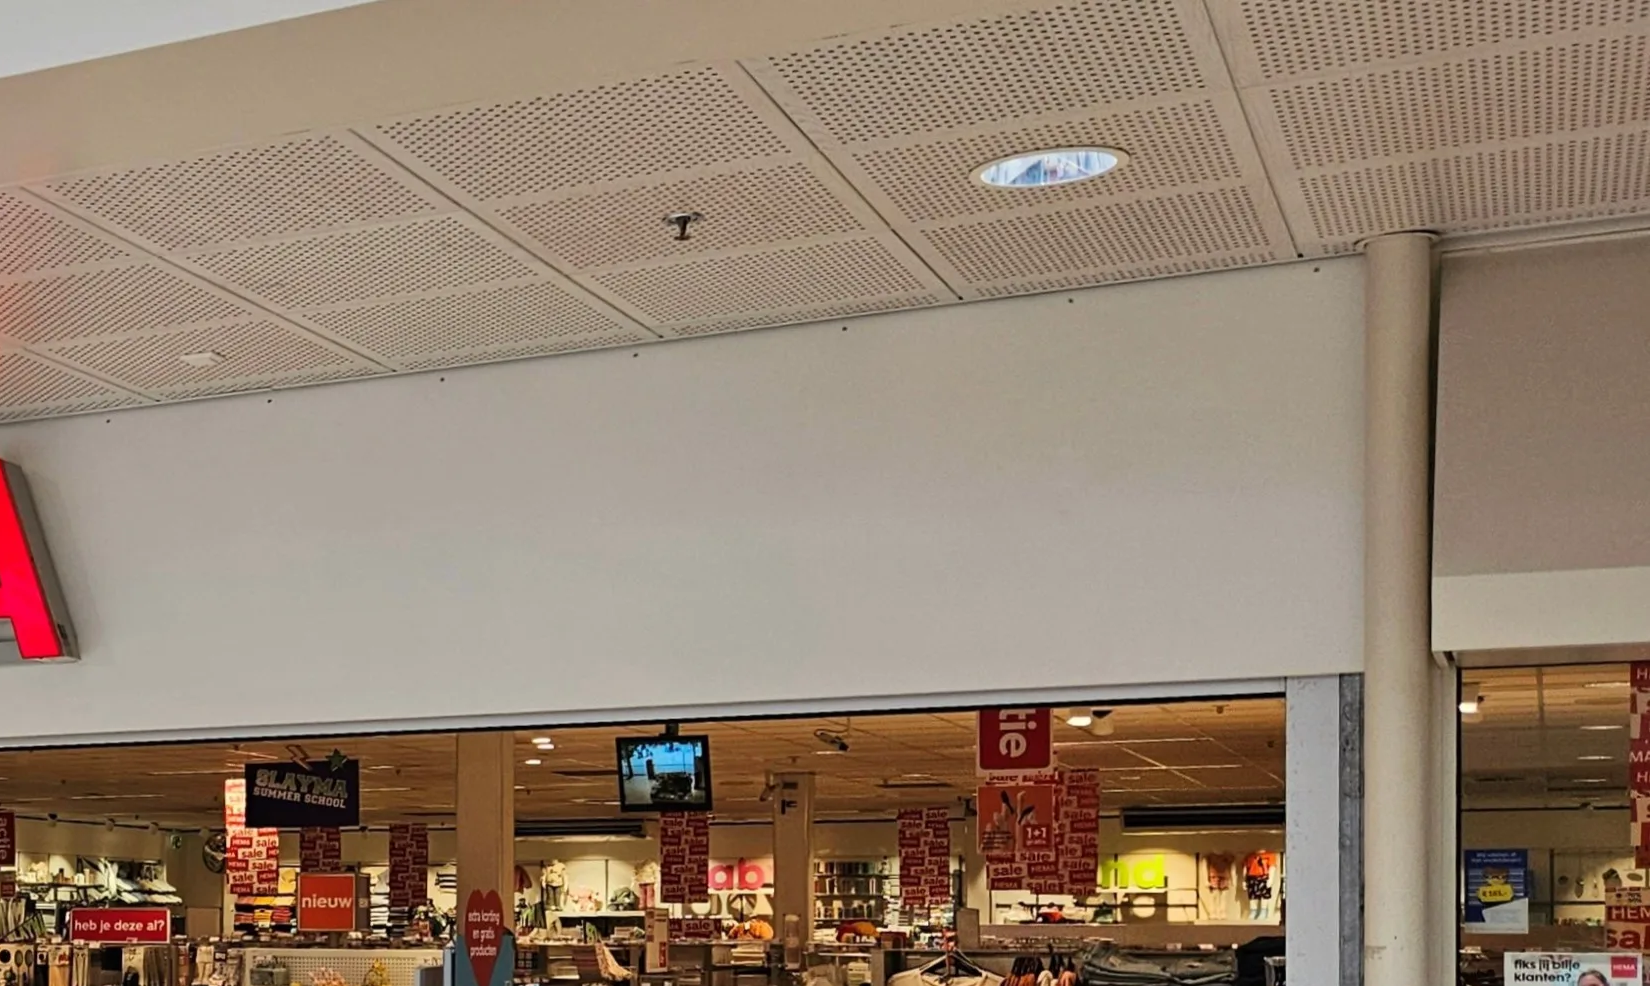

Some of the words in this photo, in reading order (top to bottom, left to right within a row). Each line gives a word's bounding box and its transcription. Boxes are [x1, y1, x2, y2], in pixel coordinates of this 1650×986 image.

[999, 709, 1037, 758] tie
[254, 768, 348, 799] SLAYMA
[252, 786, 301, 802] SUMMER
[304, 794, 346, 808] SCHOOL
[1025, 826, 1047, 840] 1+1
[255, 838, 278, 848] sale
[241, 848, 264, 859] sale
[251, 859, 274, 870] sale
[993, 863, 1023, 876] sale
[1100, 853, 1165, 889] nd
[231, 872, 255, 883] sale
[708, 857, 766, 891] ab
[255, 884, 278, 894] sale
[301, 893, 353, 909] nieuw
[1611, 905, 1650, 919] HEM
[74, 918, 97, 932] heb
[99, 919, 112, 934] je
[113, 918, 145, 932] deze
[146, 917, 166, 932] al?
[685, 919, 711, 931] sale
[1606, 924, 1650, 950] sal
[1514, 959, 1536, 970] fiks
[1612, 963, 1637, 971] HEMA
[1514, 972, 1572, 983] klanten?
